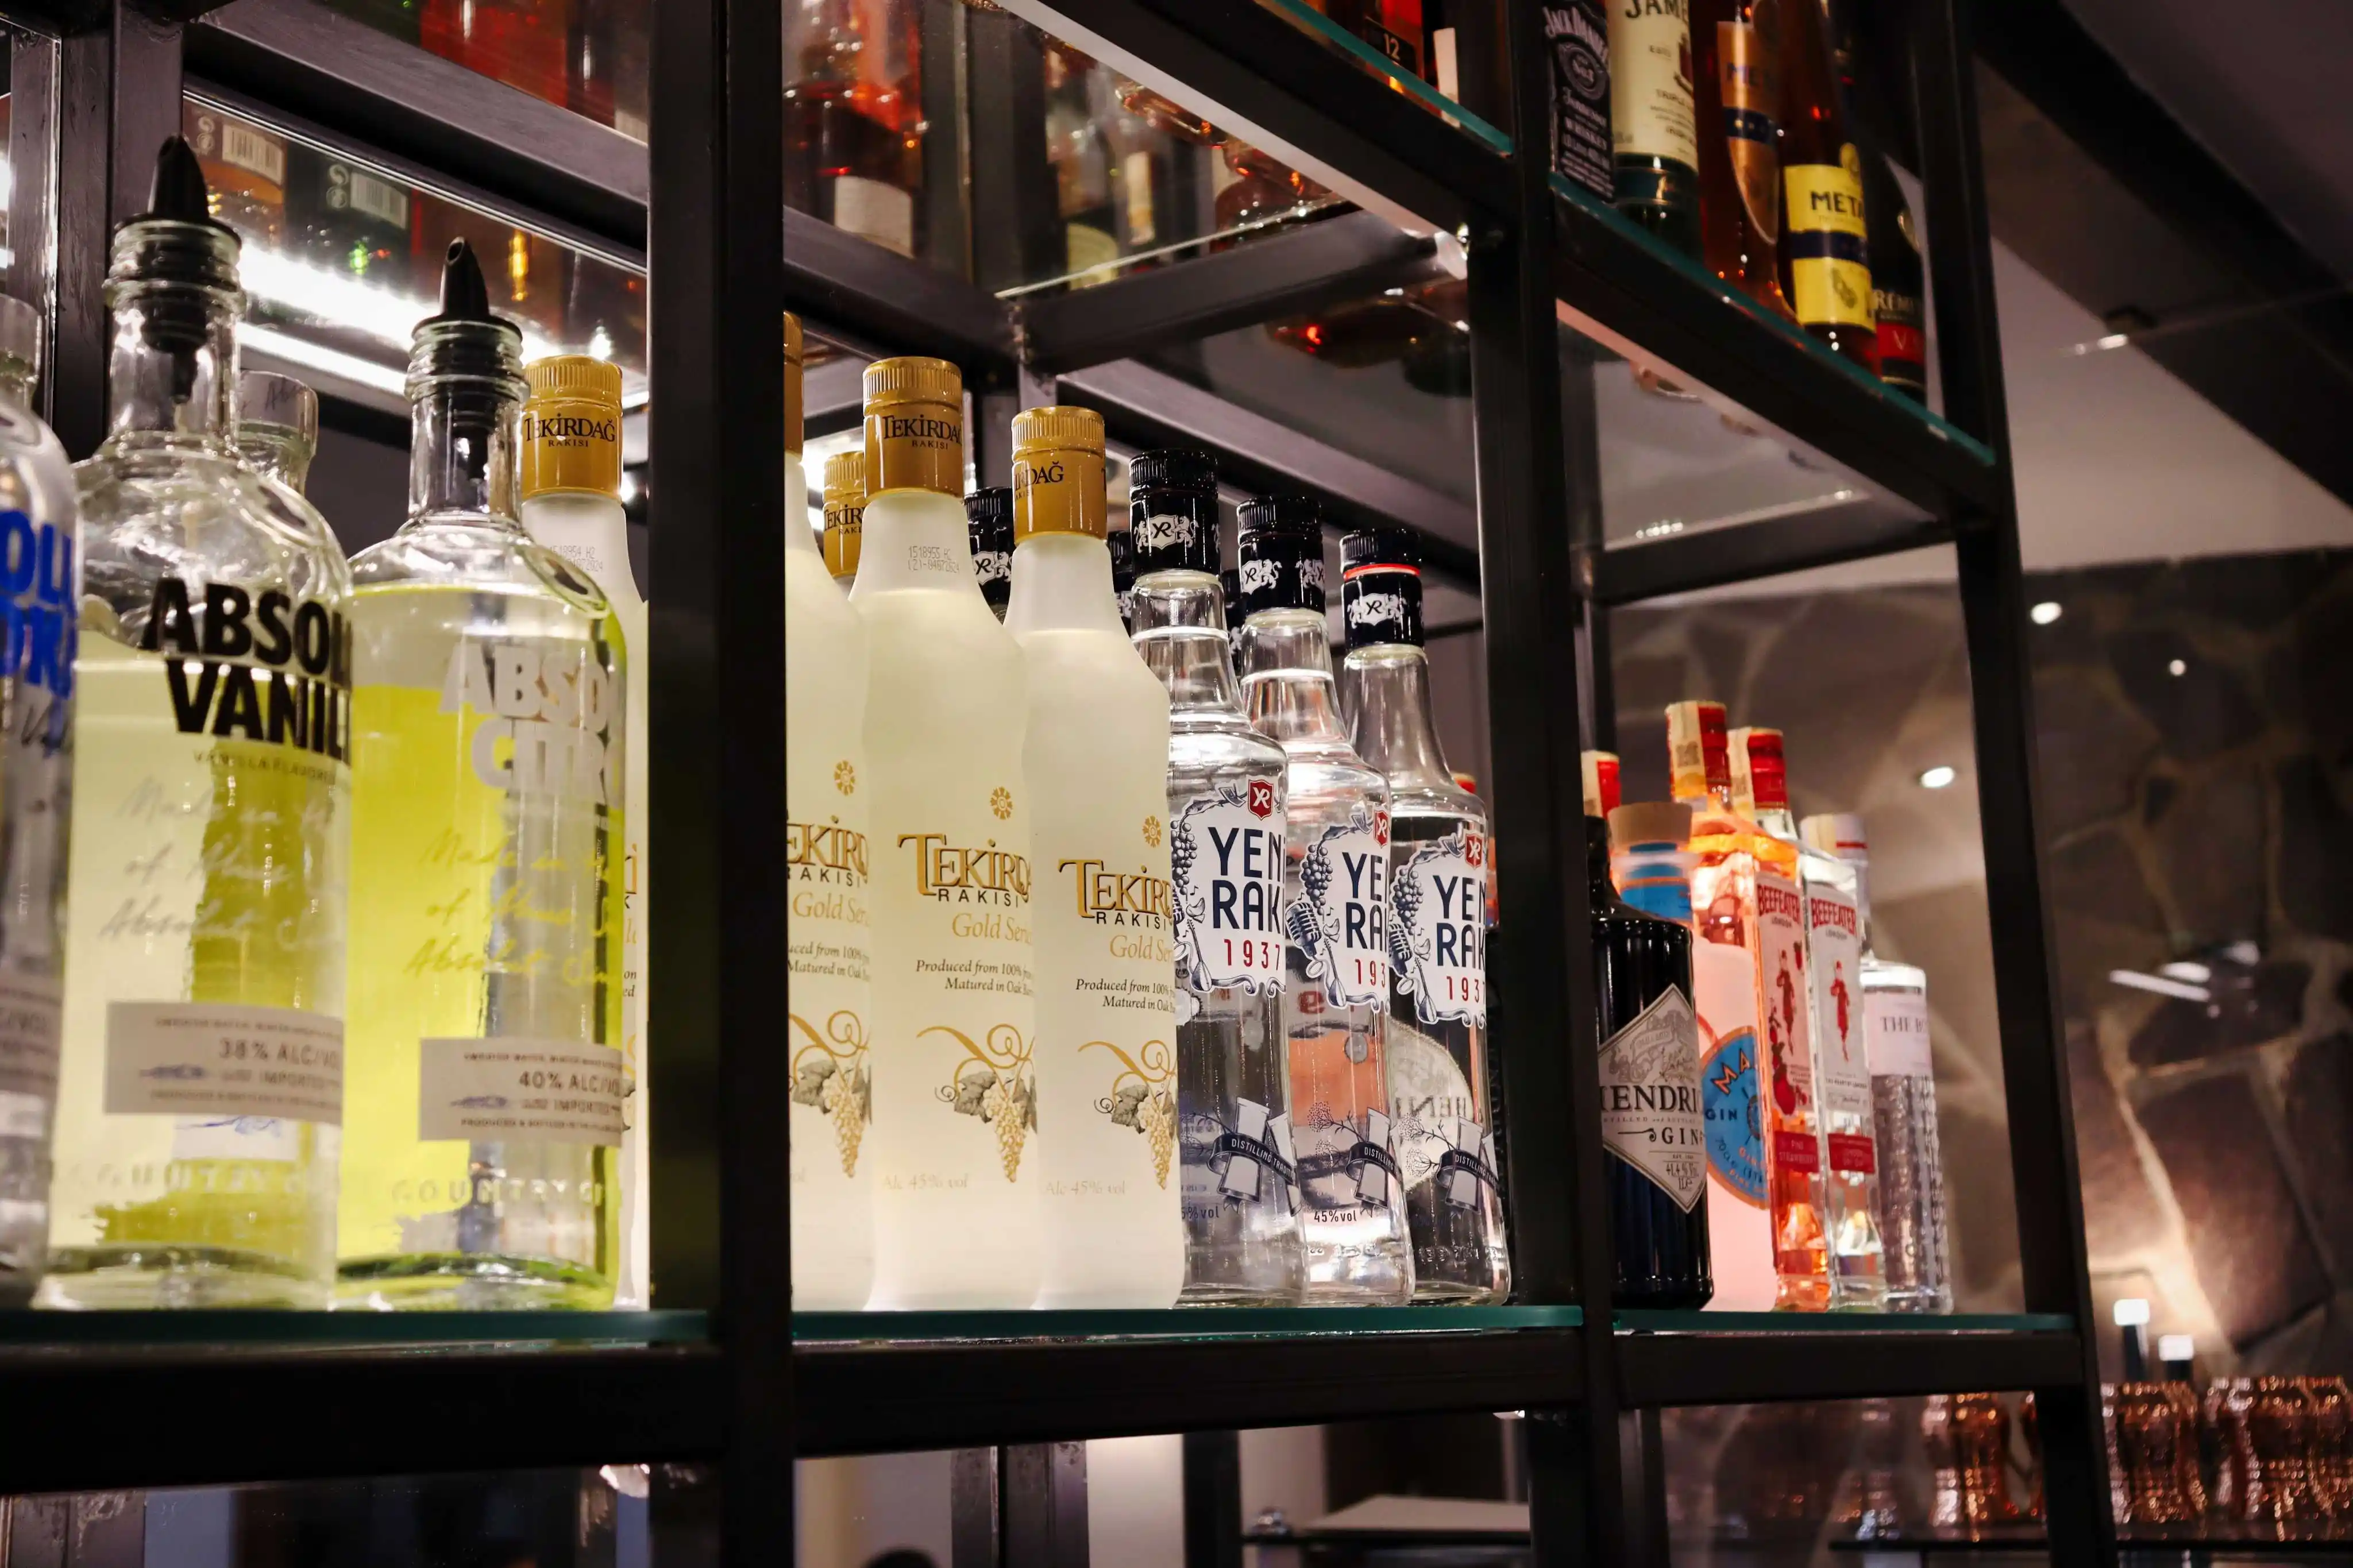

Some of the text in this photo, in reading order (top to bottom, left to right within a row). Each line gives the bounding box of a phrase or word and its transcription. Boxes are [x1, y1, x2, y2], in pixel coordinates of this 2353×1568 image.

[1383, 33, 1401, 61] 12
[912, 439, 948, 450] RAKISI
[824, 503, 865, 532] TEKİR
[792, 890, 843, 920] Gold
[938, 887, 1019, 908] RAKISI
[1757, 883, 1802, 926] BEEFEATER
[952, 913, 1001, 939] Gold
[1096, 911, 1167, 931] RAKISI
[1810, 897, 1857, 940] BEEFEATER
[814, 943, 840, 959] from
[1110, 934, 1154, 960] Gold
[1224, 938, 1280, 971] 1937
[915, 958, 972, 972] Produced
[972, 959, 999, 976] from
[944, 976, 994, 991] Matured
[996, 980, 1005, 992] in
[1075, 978, 1127, 992] Produced
[1127, 979, 1150, 995] from
[1102, 995, 1146, 1010] Matured
[1148, 999, 1155, 1010] in
[519, 1071, 562, 1090] 40%
[1704, 1108, 1738, 1121] GIN
[1661, 1126, 1699, 1145] GIN
[1231, 1138, 1272, 1164] DISTILLING
